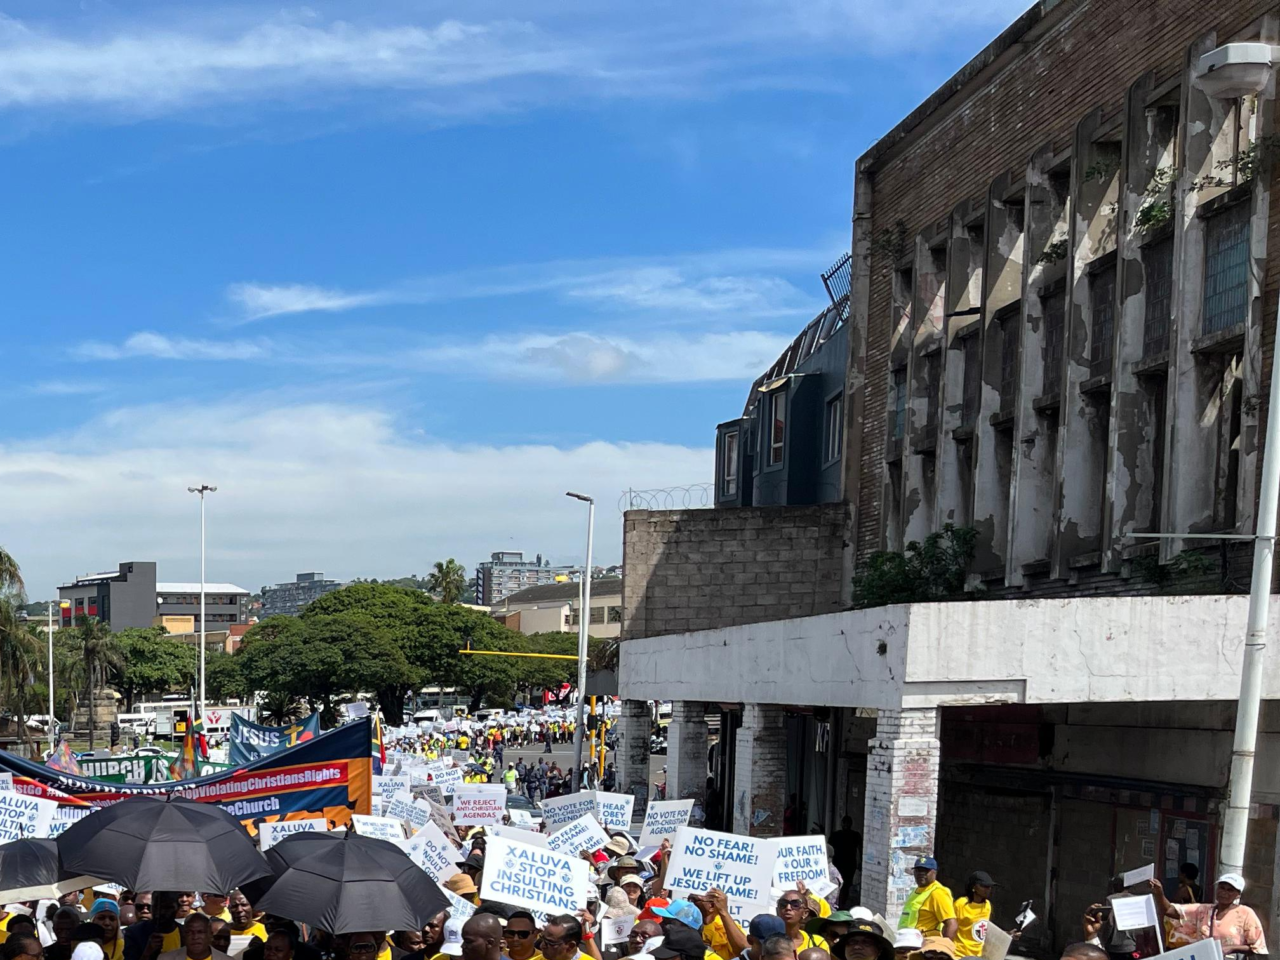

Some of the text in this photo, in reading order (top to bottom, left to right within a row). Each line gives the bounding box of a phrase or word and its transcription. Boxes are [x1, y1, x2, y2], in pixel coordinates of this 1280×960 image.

[235, 725, 280, 747] JESUS
[543, 799, 594, 815] NO VOTE FOR
[545, 805, 595, 820] ANTI-CHRISTIAN
[603, 803, 625, 811] HEAR
[603, 810, 626, 818] OBEY
[647, 809, 689, 820] NO VOTE FOR
[271, 822, 315, 833] XALUVA
[646, 817, 688, 827] ANTI-CHRISTIAN
[548, 822, 581, 846] NO FEAR!
[561, 826, 589, 846] SHAME!
[570, 836, 595, 857] LIFT UP
[693, 835, 754, 853] NO FEAR!
[796, 845, 825, 856] FAITH,
[426, 840, 451, 868] DO NOT
[506, 845, 572, 872] XALUVA
[684, 846, 759, 865] NO SHAME!
[791, 858, 812, 868] OUR
[518, 862, 556, 879] STOP
[682, 868, 752, 886] WE LIFT UP
[778, 869, 827, 883] FREEDOM!
[497, 869, 574, 898] INSULTING
[670, 877, 758, 900] JESUS' NAME!
[490, 881, 578, 912] CHRISTIANS
